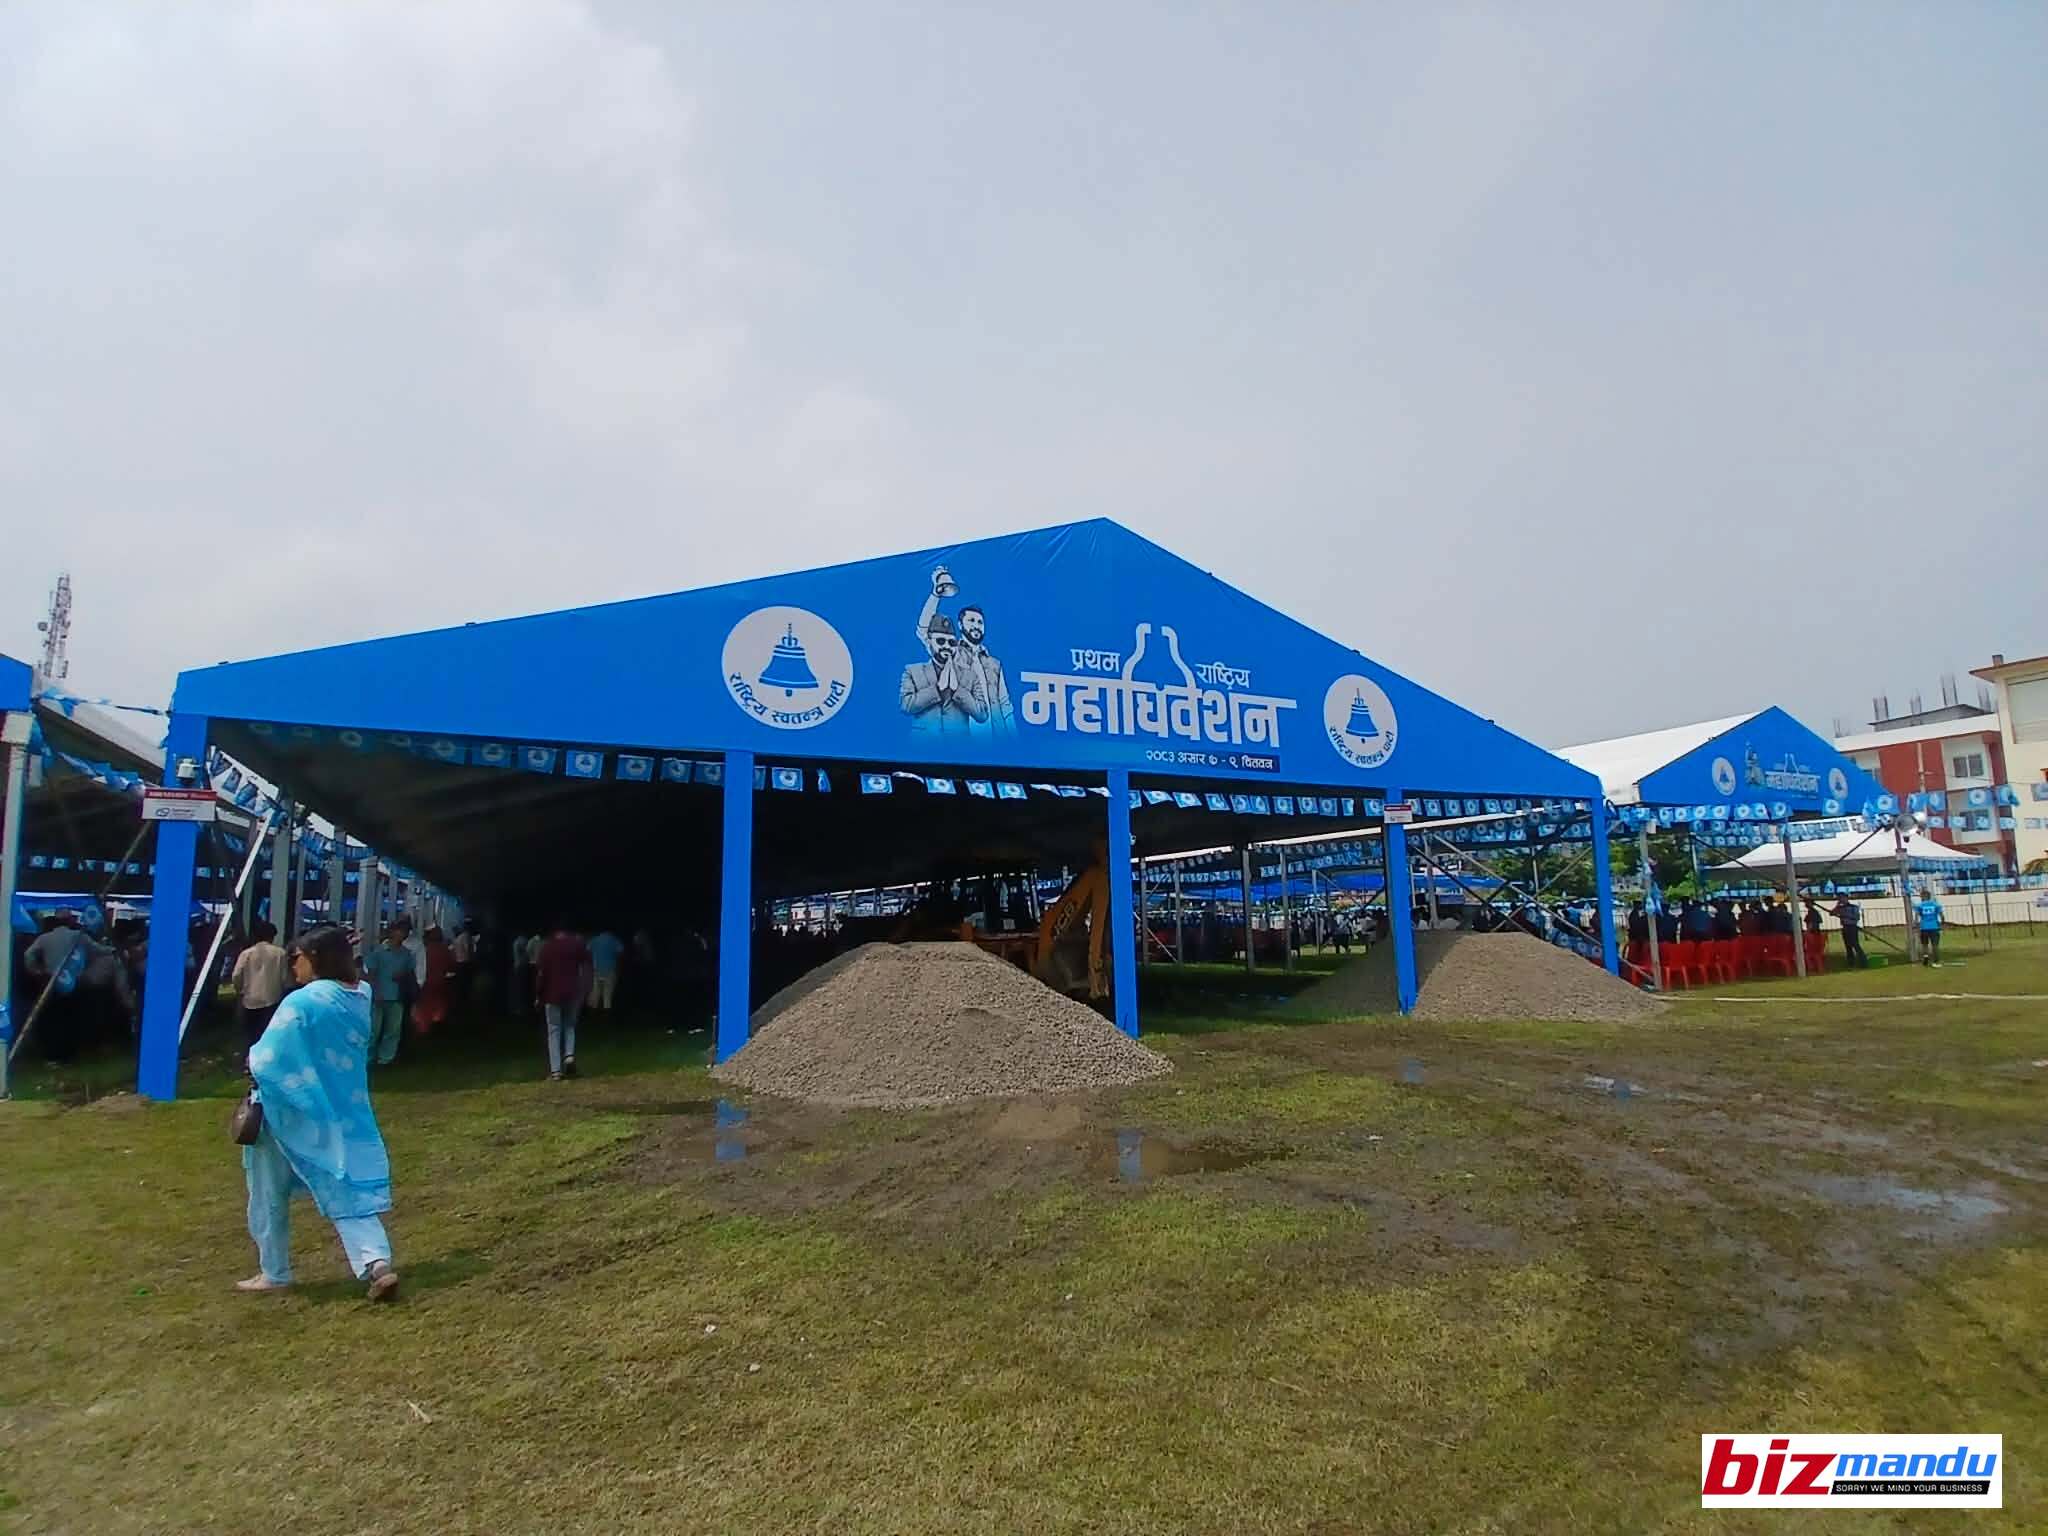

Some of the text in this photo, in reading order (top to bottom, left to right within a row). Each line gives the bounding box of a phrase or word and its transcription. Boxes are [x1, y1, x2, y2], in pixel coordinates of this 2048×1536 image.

[1070, 648, 1250, 689] प्रथम राष्ट्रिय
[1178, 752, 1206, 765] असार
[1242, 754, 1273, 769] चितवन
